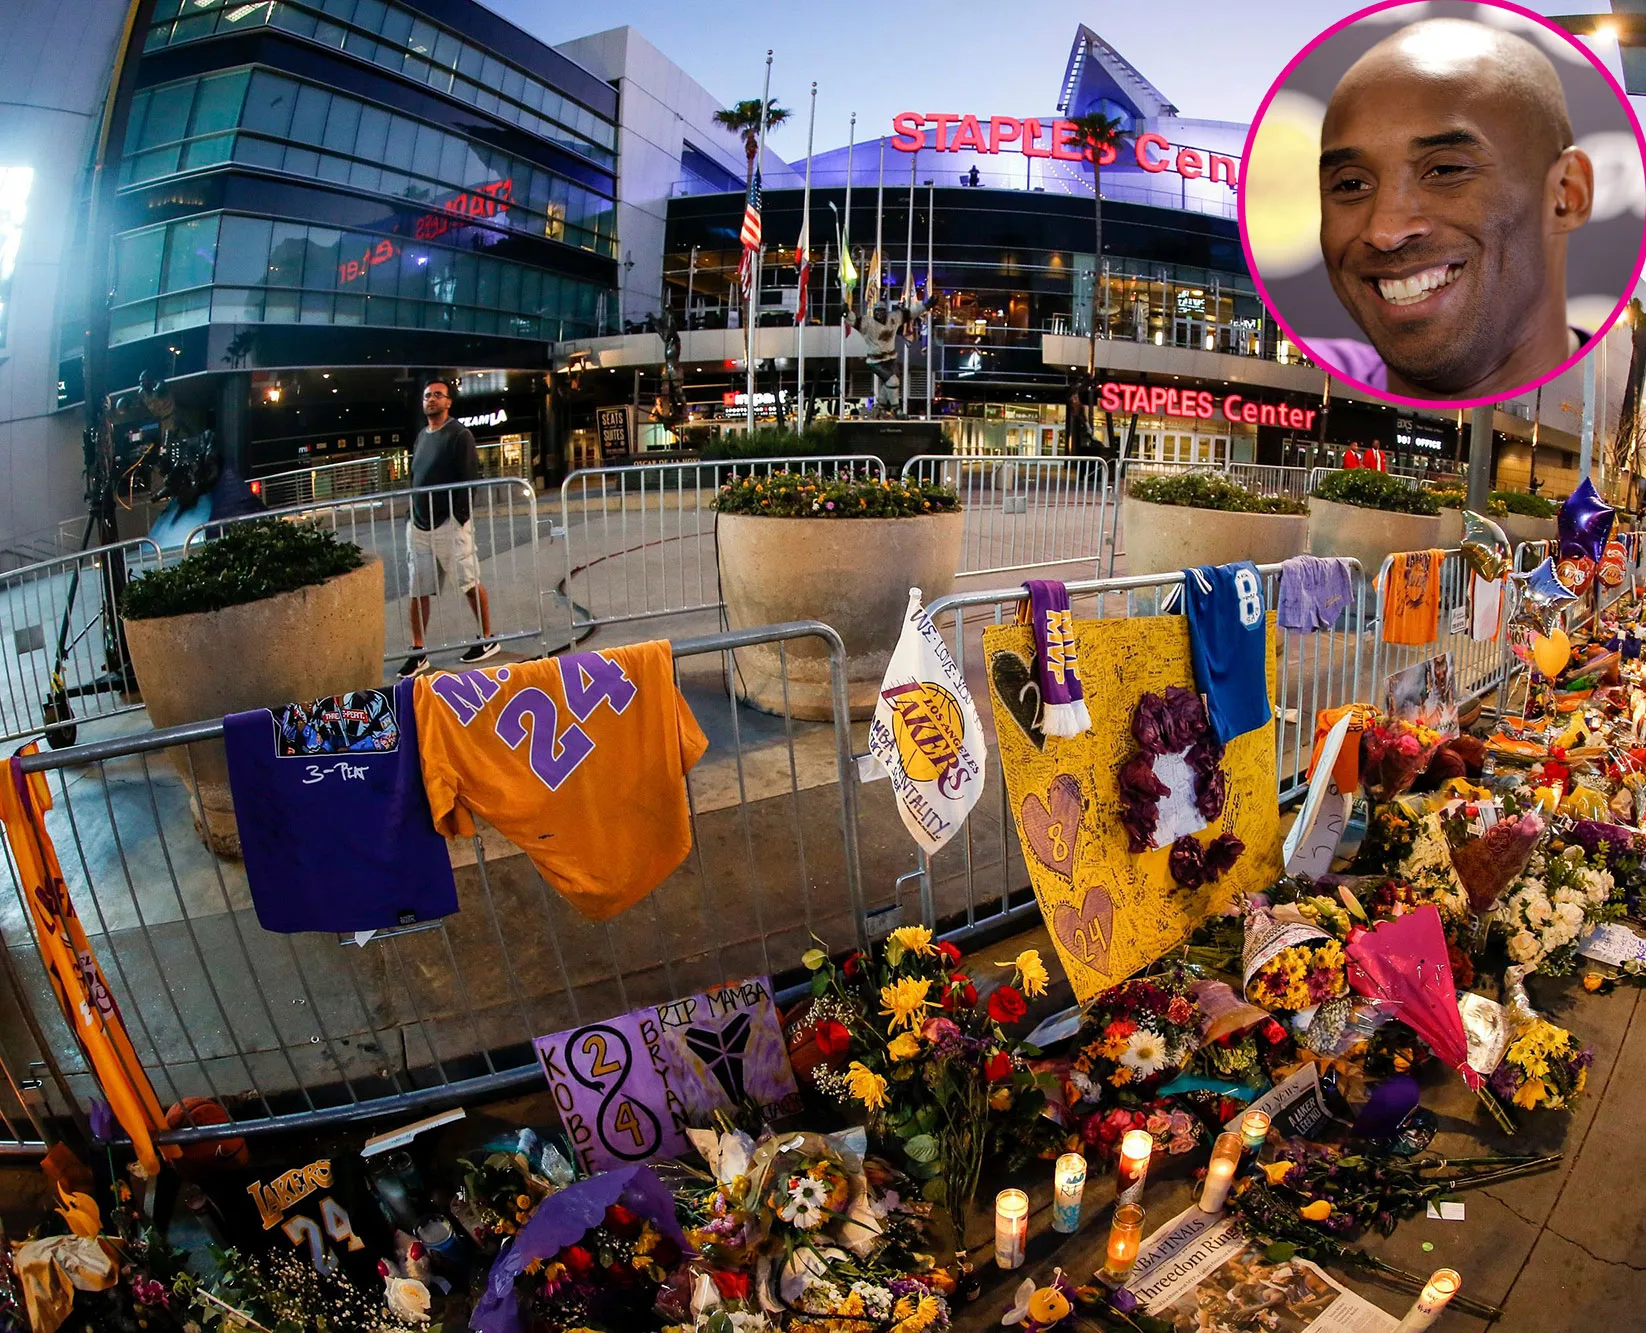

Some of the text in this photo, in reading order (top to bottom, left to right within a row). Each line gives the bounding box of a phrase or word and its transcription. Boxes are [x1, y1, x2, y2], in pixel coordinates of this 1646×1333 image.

[891, 112, 1118, 166] STAPLES
[602, 412, 624, 426] SEATS
[1101, 381, 1317, 430] STAPLES Center
[603, 429, 625, 442] SUITES
[1235, 567, 1262, 627] 8
[1045, 609, 1065, 685] MVP
[495, 650, 637, 792] 24
[881, 678, 972, 801] LAKERS
[922, 698, 944, 722] LOS
[940, 722, 980, 775] ANGELES
[1047, 822, 1068, 863] 8
[1074, 916, 1108, 964] 24
[656, 981, 770, 1033] RIP MAMBA
[1294, 1096, 1318, 1122] LAKER
[1295, 1107, 1321, 1135] LEGEND
[246, 1158, 334, 1231] LAKERS
[281, 1195, 366, 1277] 24
[1131, 1250, 1162, 1277] NBA
[1156, 1218, 1205, 1256] FINALS
[1134, 1251, 1208, 1305] Threedom
